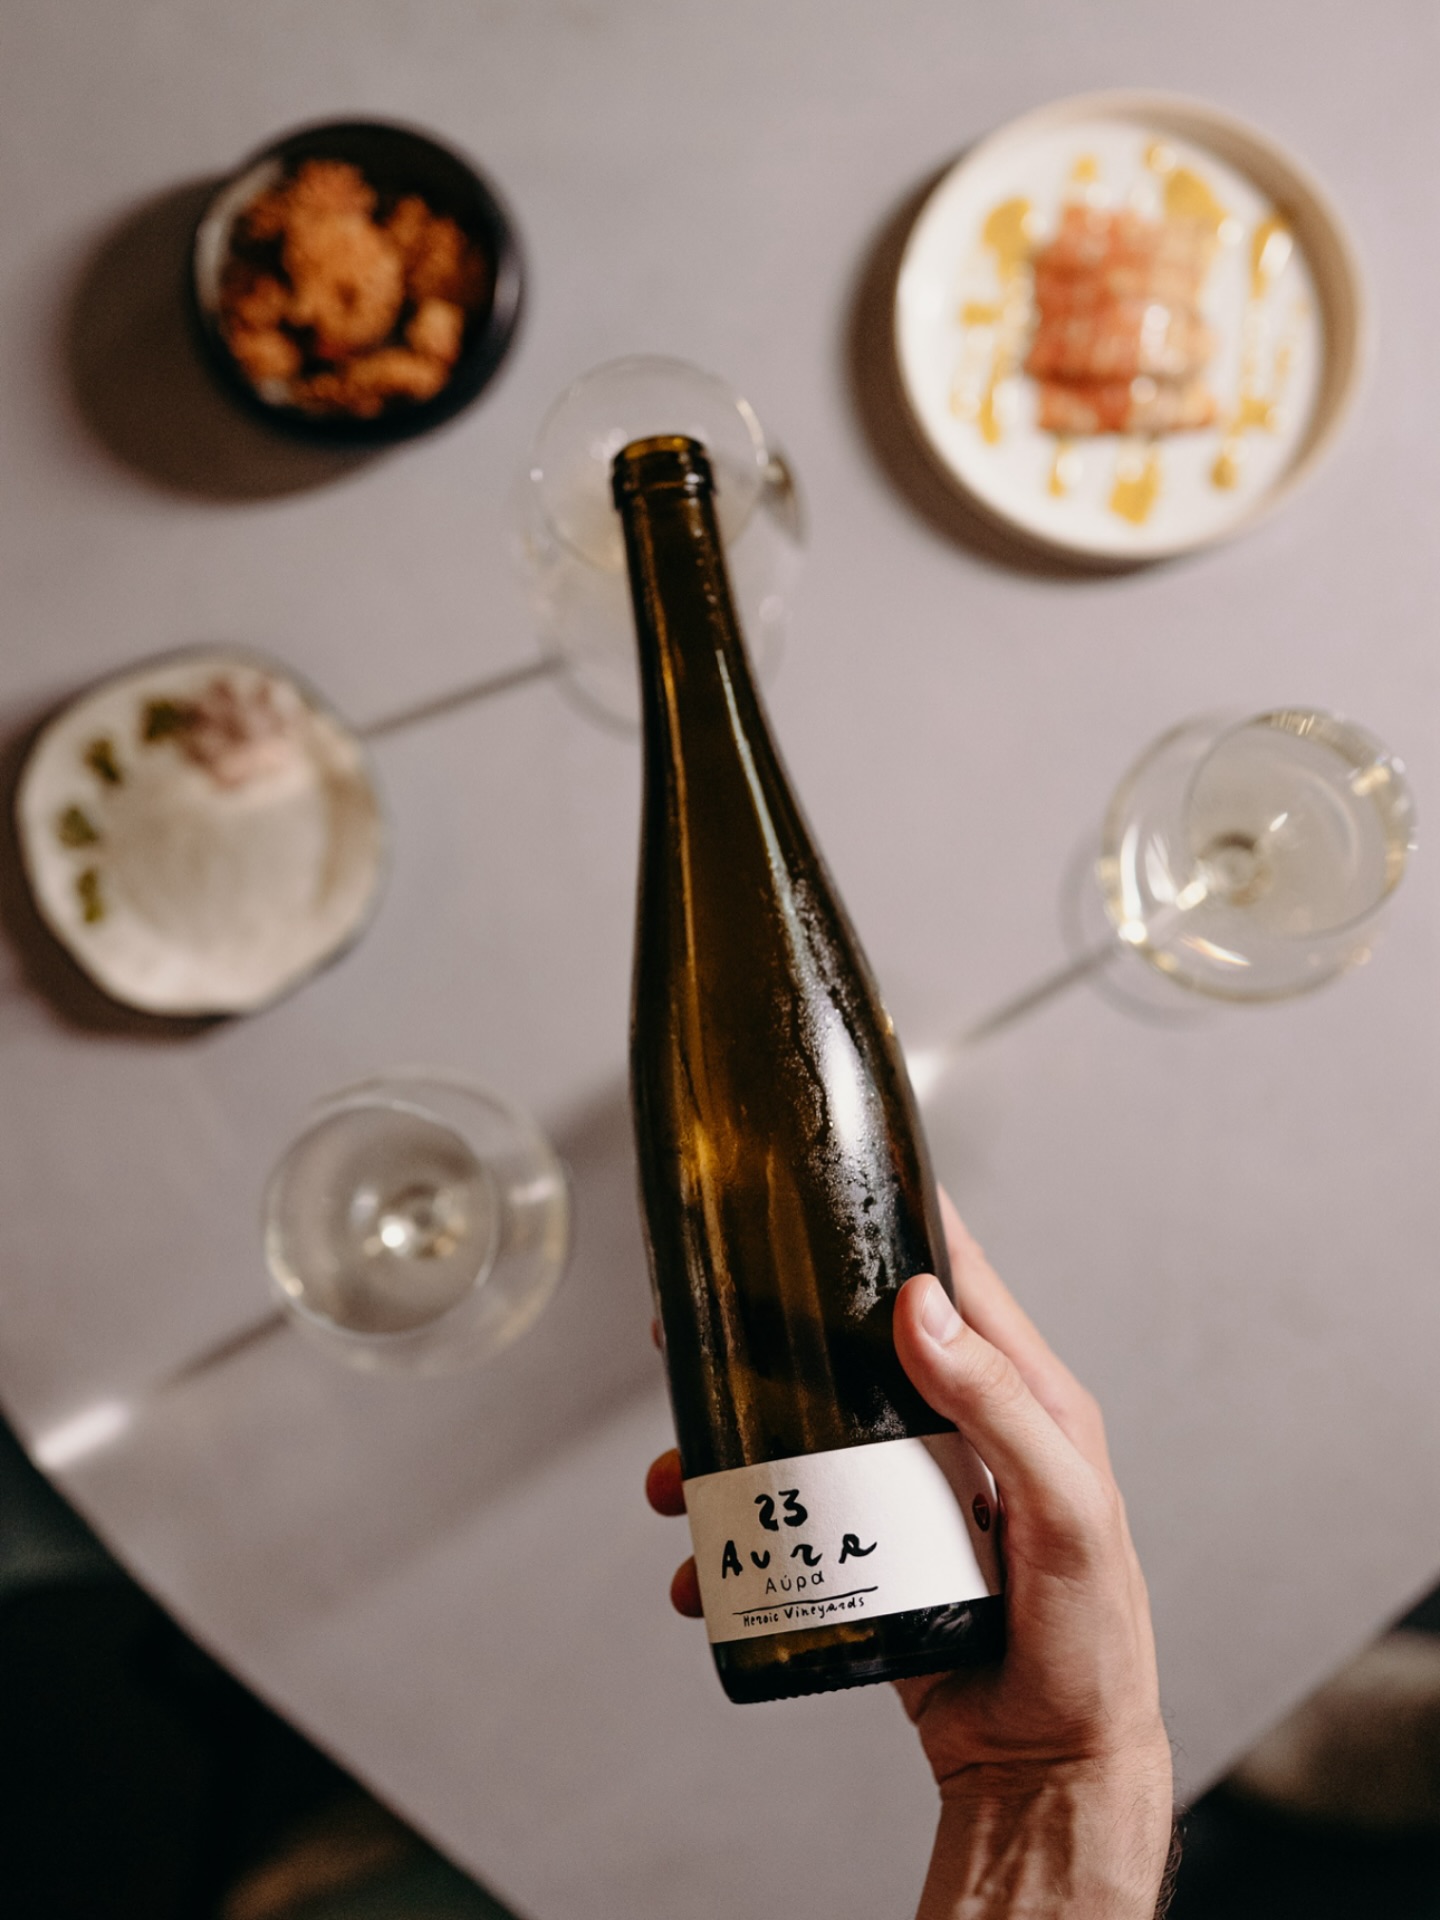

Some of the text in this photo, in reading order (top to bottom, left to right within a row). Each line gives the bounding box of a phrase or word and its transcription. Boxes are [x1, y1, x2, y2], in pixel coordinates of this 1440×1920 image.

[754, 1489, 808, 1531] 23
[743, 1597, 865, 1627] Heroic Vineyards
